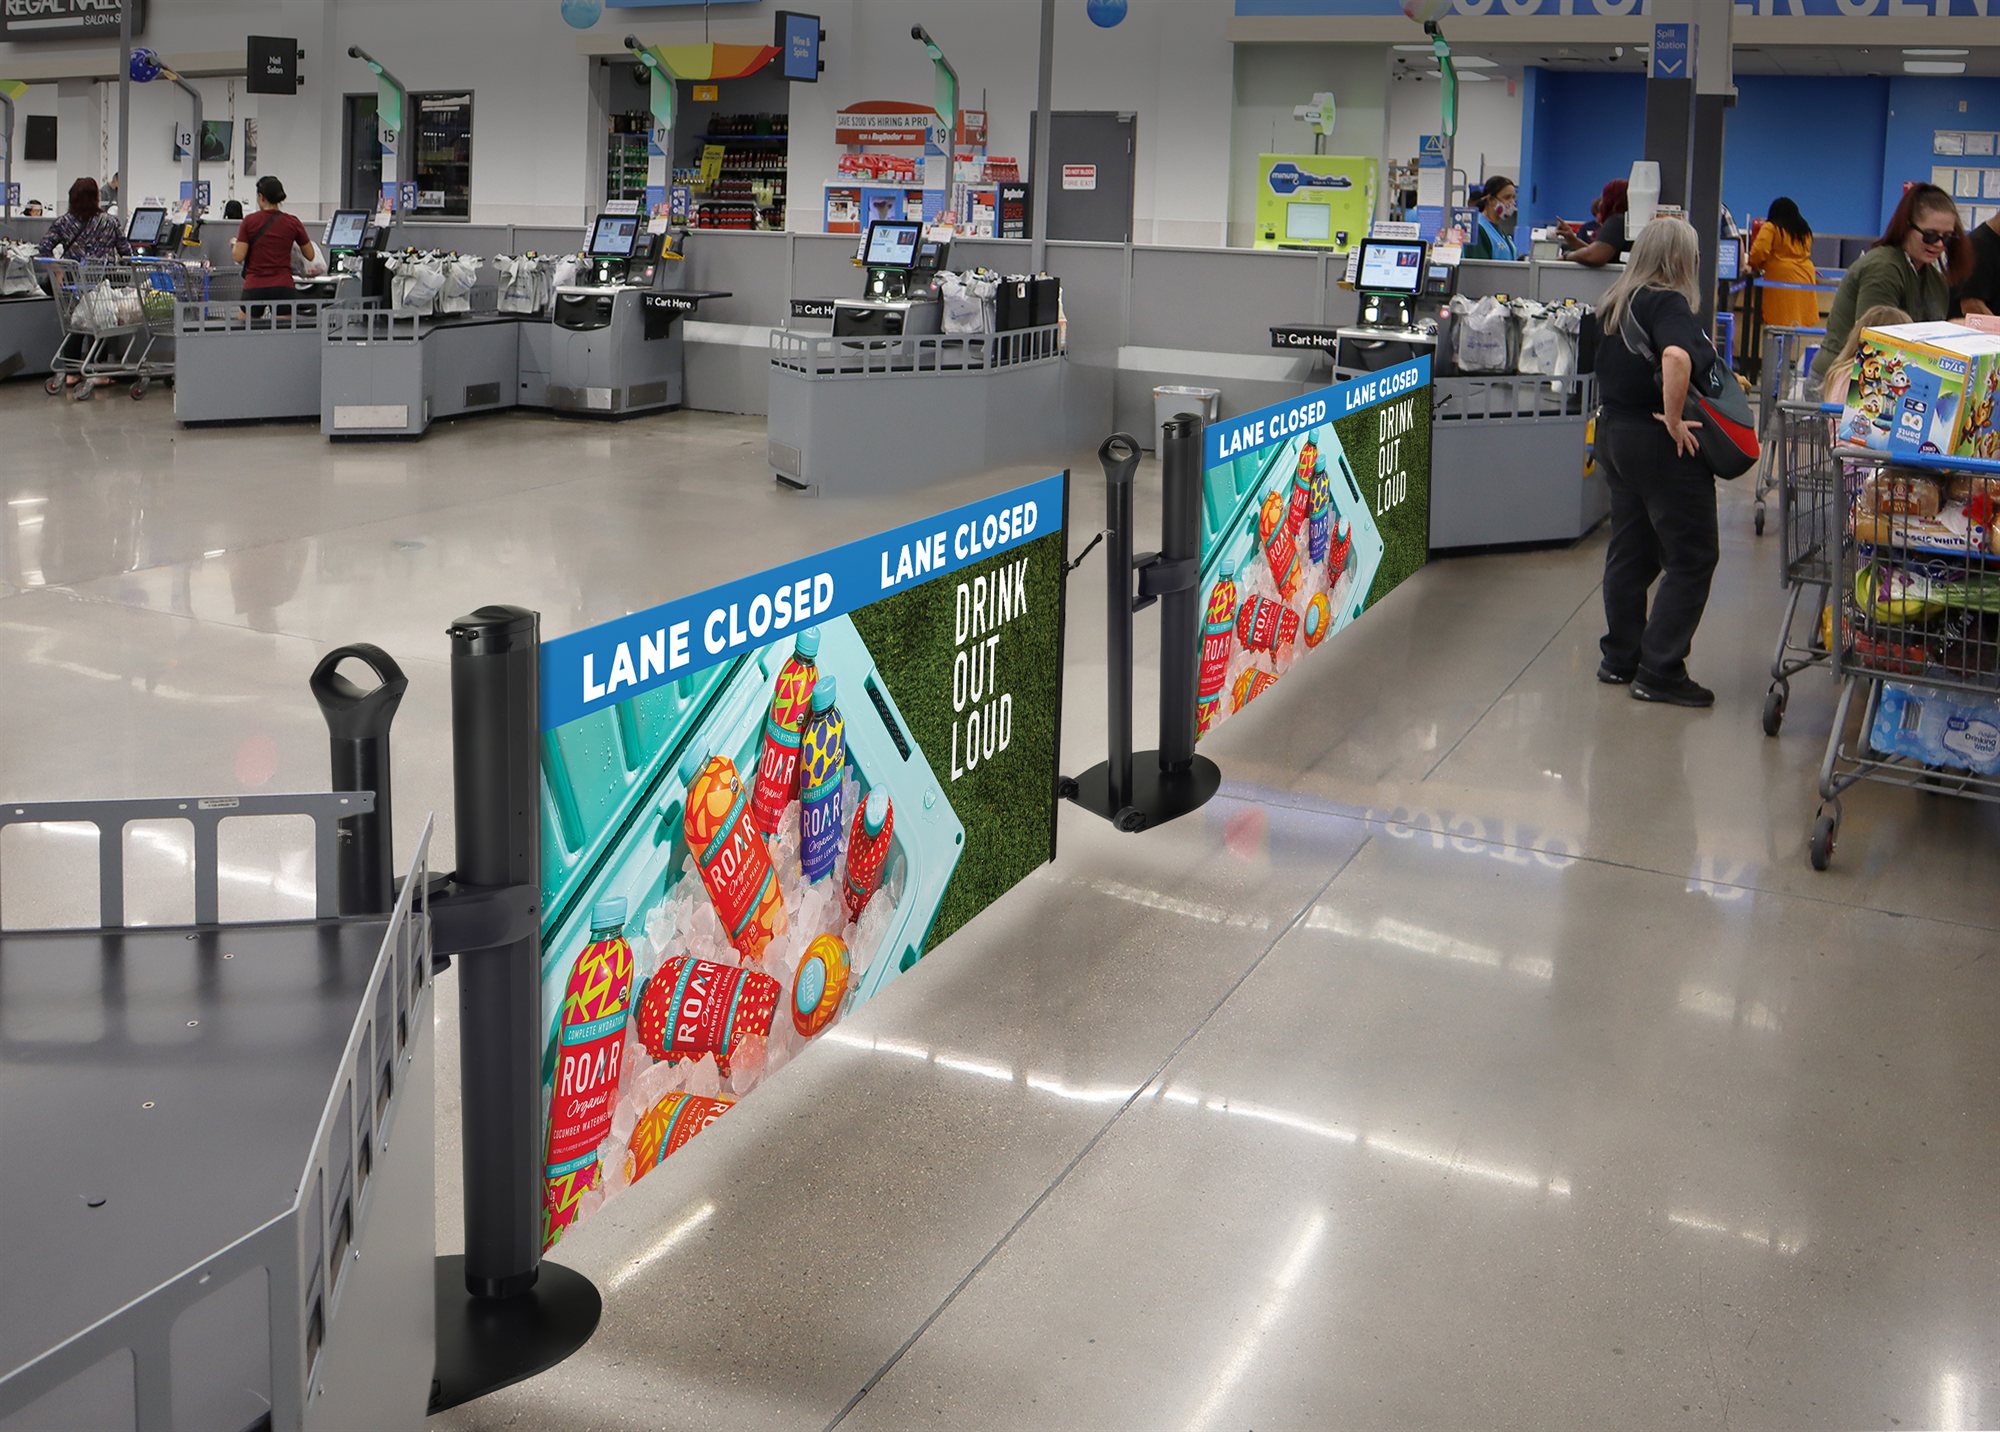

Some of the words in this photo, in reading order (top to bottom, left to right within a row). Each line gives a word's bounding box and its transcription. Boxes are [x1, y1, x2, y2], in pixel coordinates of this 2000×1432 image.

[1656, 29, 1675, 39] Spill
[1656, 40, 1686, 50] Station
[266, 65, 284, 74] Salon
[269, 56, 281, 65] Nail
[657, 128, 666, 142] 17
[838, 116, 850, 126] SAVE
[868, 116, 876, 126] VS
[878, 116, 902, 126] HIRING
[904, 117, 910, 126] A
[911, 116, 928, 126] PRO
[181, 133, 191, 146] 13
[383, 130, 395, 143] 15
[936, 129, 947, 144] 19
[655, 297, 671, 307] Cart
[672, 299, 692, 309] Here
[804, 304, 822, 315] Cart
[1288, 333, 1311, 345] Cart
[1219, 420, 1264, 459] LANE
[1269, 400, 1326, 438] CLOSED
[1345, 382, 1376, 410] LANE
[1379, 368, 1418, 397] CLOSED
[1379, 398, 1414, 442] DRINK
[1895, 432, 1920, 446] training
[1897, 428, 1921, 440] pants
[1378, 439, 1400, 480] OUT
[1377, 471, 1406, 517] LOUD
[1269, 522, 1291, 563] ROAR
[583, 620, 690, 703] LANE
[704, 572, 834, 655] CLOSED
[881, 531, 947, 589] LANE
[954, 501, 1038, 560] CLOSED
[955, 557, 1028, 647] DRINK
[1254, 599, 1271, 642] ROAR
[1204, 635, 1230, 662] ROAR
[953, 634, 1000, 713] OUT
[951, 693, 1012, 782] LOUD
[1965, 732, 1997, 746] Drinking
[1973, 743, 1996, 753] Water
[760, 739, 796, 785] ROAR
[703, 829, 725, 862] COMPLETE
[724, 796, 744, 831] HYDRATION
[803, 792, 840, 838] ROAR
[710, 813, 756, 893] ROAR
[728, 847, 756, 896] Organic
[732, 880, 750, 909] GEORGIA
[677, 962, 718, 1043] ROAR
[701, 972, 722, 1028] Organic
[568, 1025, 597, 1041] COMPLETE
[599, 1014, 627, 1033] HYDRATION
[665, 994, 682, 1040] COMPLETE
[707, 993, 724, 1046] STRAWBERRY
[561, 1041, 620, 1097] ROAR
[567, 1091, 609, 1119] Organic
[553, 1124, 581, 1140] CUCUMBER
